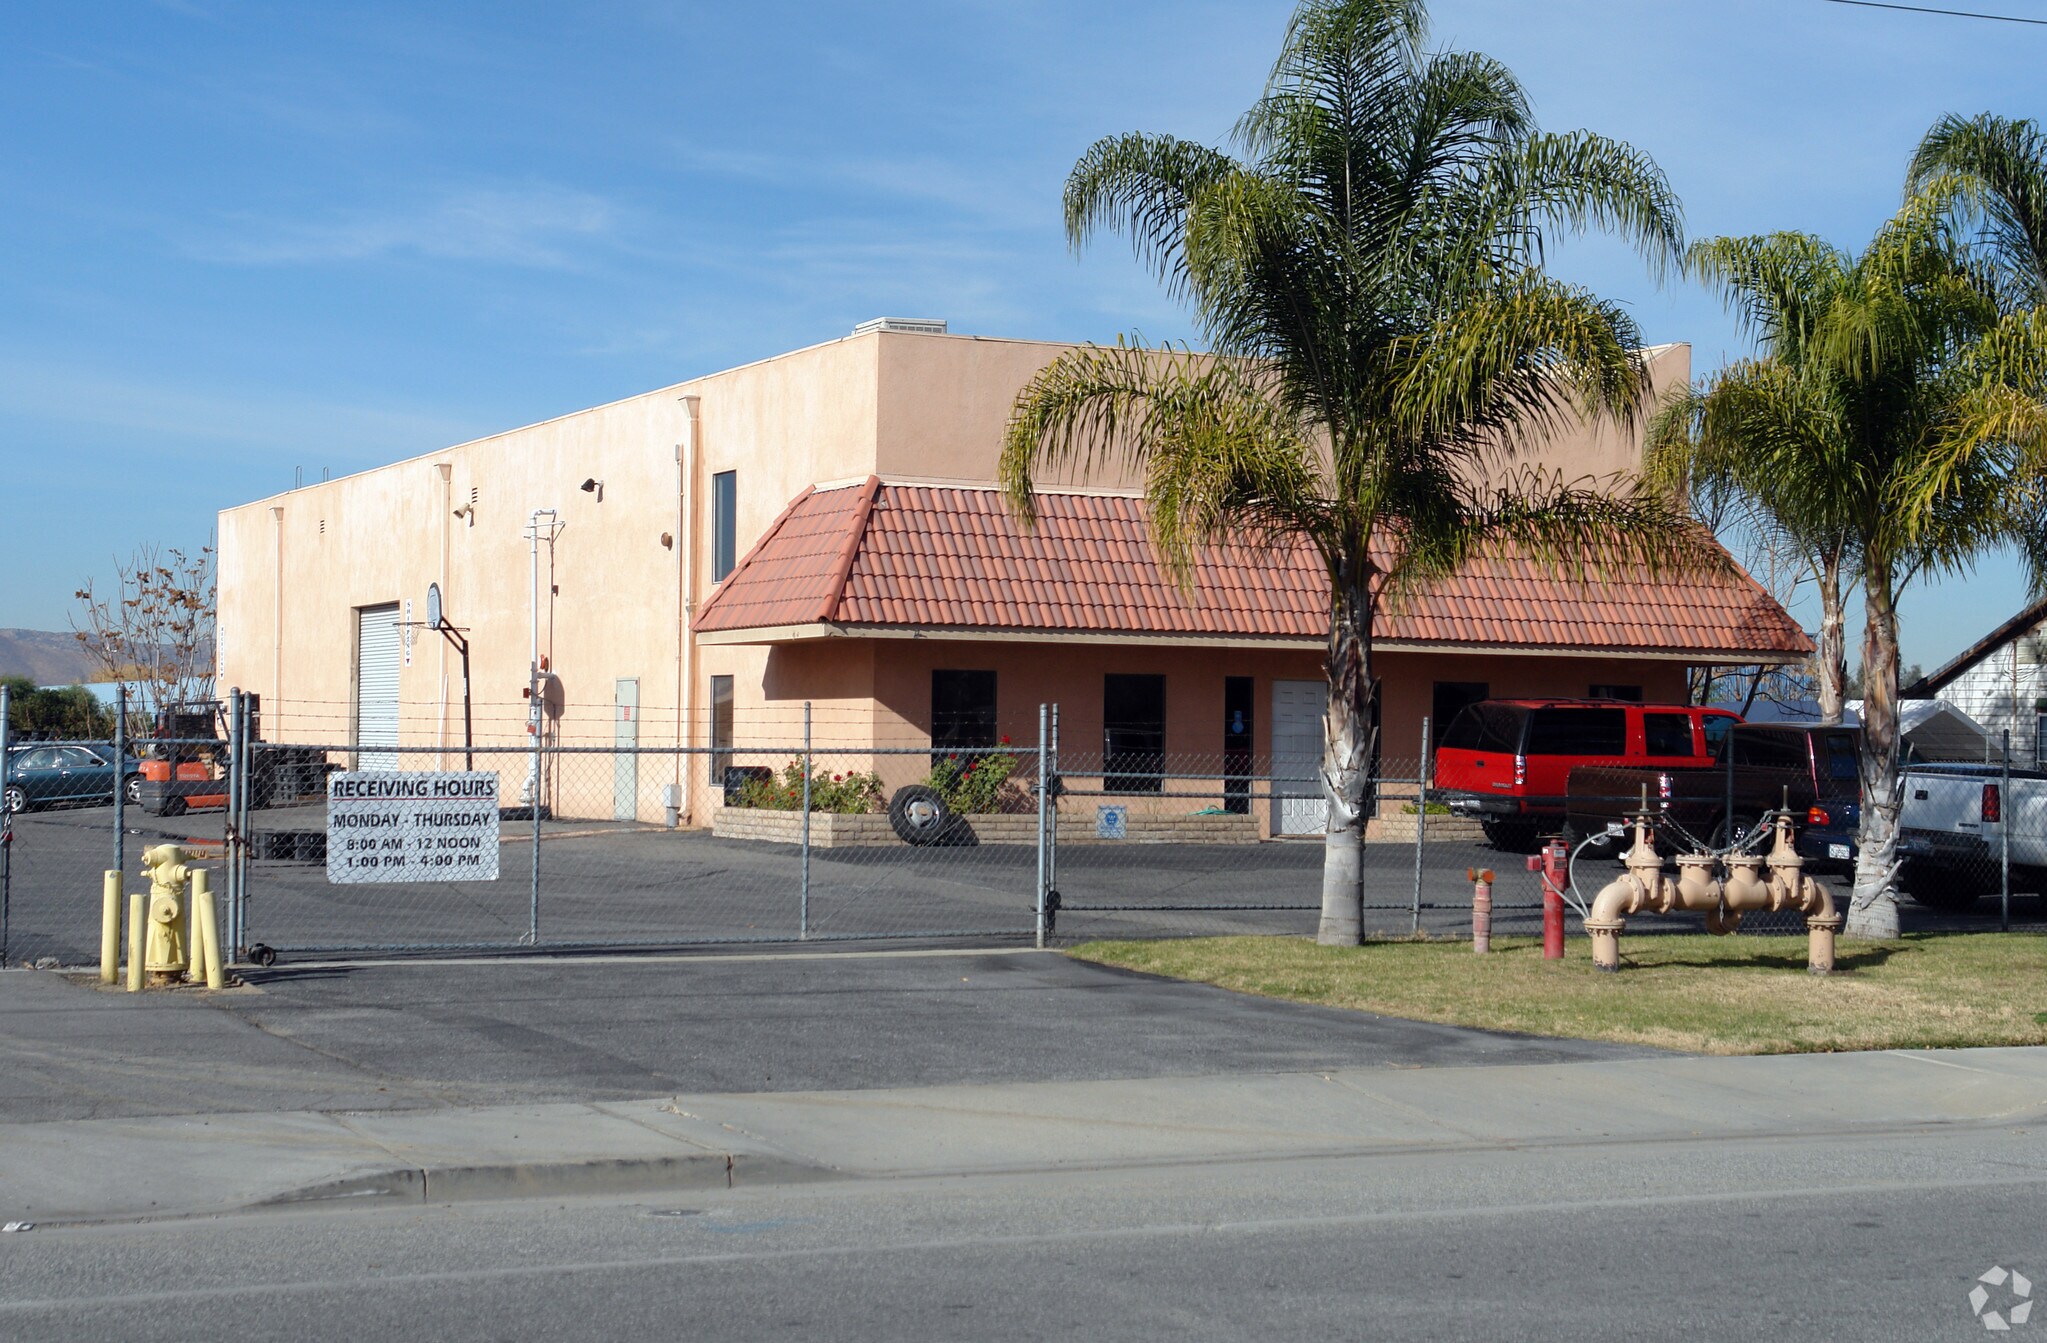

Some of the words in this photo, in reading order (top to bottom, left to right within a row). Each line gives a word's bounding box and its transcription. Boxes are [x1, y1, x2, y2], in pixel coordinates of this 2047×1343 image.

[334, 780, 427, 796] RECEIVING
[434, 780, 493, 796] HOURS
[334, 813, 400, 828] MONDAY
[414, 813, 490, 827] THURSDAY
[347, 838, 376, 850] 8:00
[382, 838, 404, 850] AM
[417, 838, 432, 849] 12
[437, 837, 480, 849] NOON
[347, 856, 378, 868] 1:00
[384, 856, 405, 867] PM
[421, 855, 453, 867] 4:00
[458, 855, 480, 866] PM
